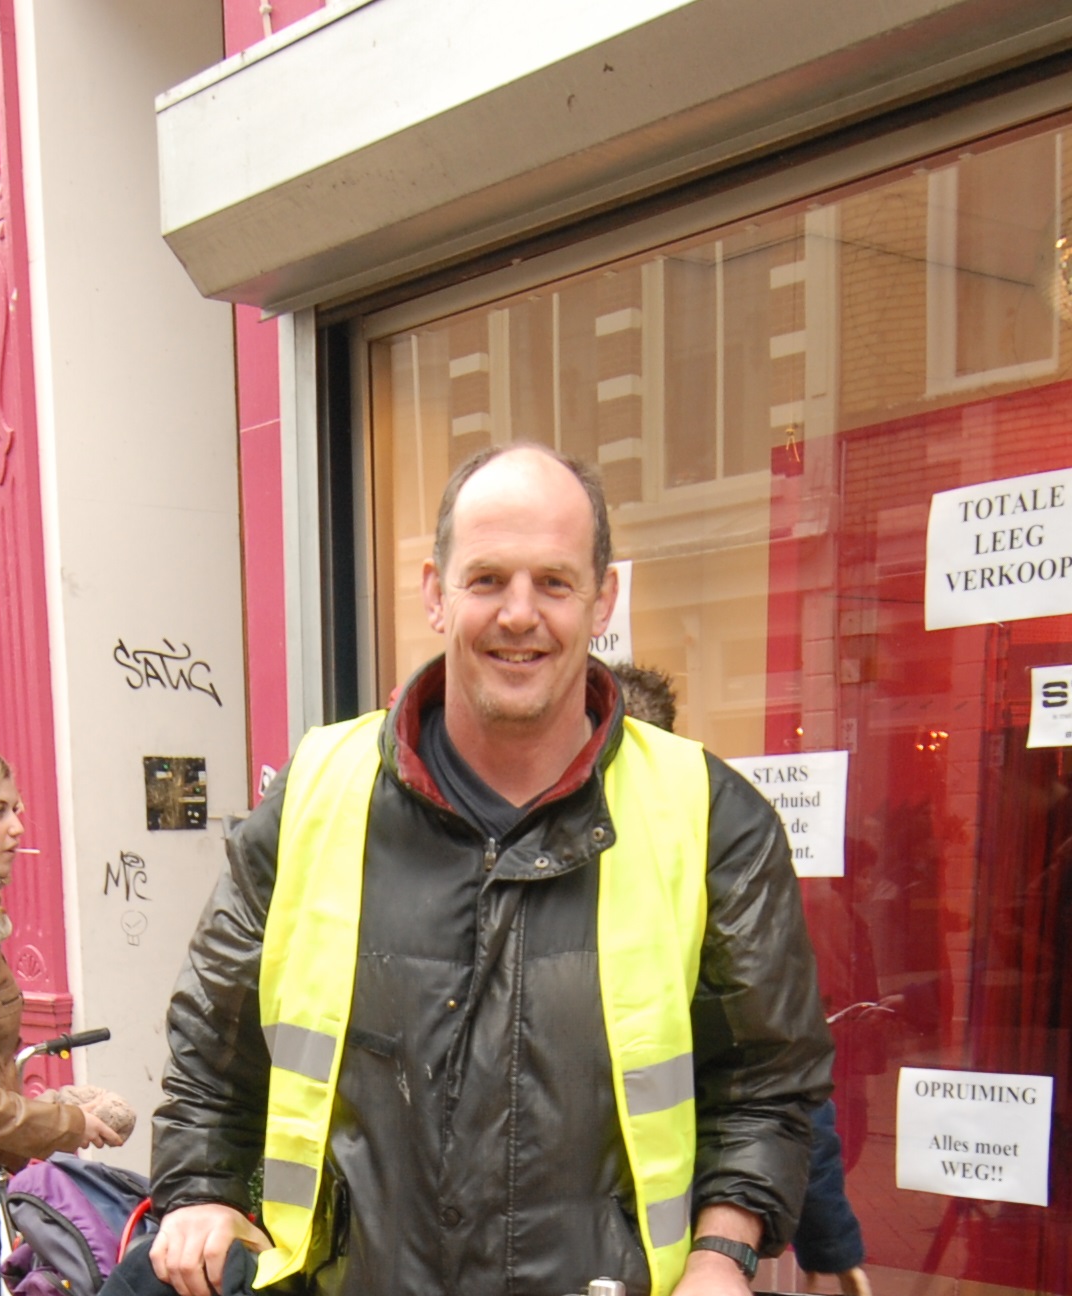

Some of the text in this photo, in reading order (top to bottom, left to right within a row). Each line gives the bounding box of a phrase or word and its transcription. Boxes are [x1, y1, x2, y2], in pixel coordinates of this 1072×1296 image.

[959, 484, 1065, 522] TOTALE
[974, 524, 1045, 555] LEEG
[945, 556, 1072, 593] VERKOOP
[752, 765, 809, 785] STARS
[791, 818, 809, 834] de
[915, 1080, 1037, 1105] OPRUIMING
[929, 1134, 1020, 1157] Alles moet
[941, 1160, 1003, 1182] WEG!!
